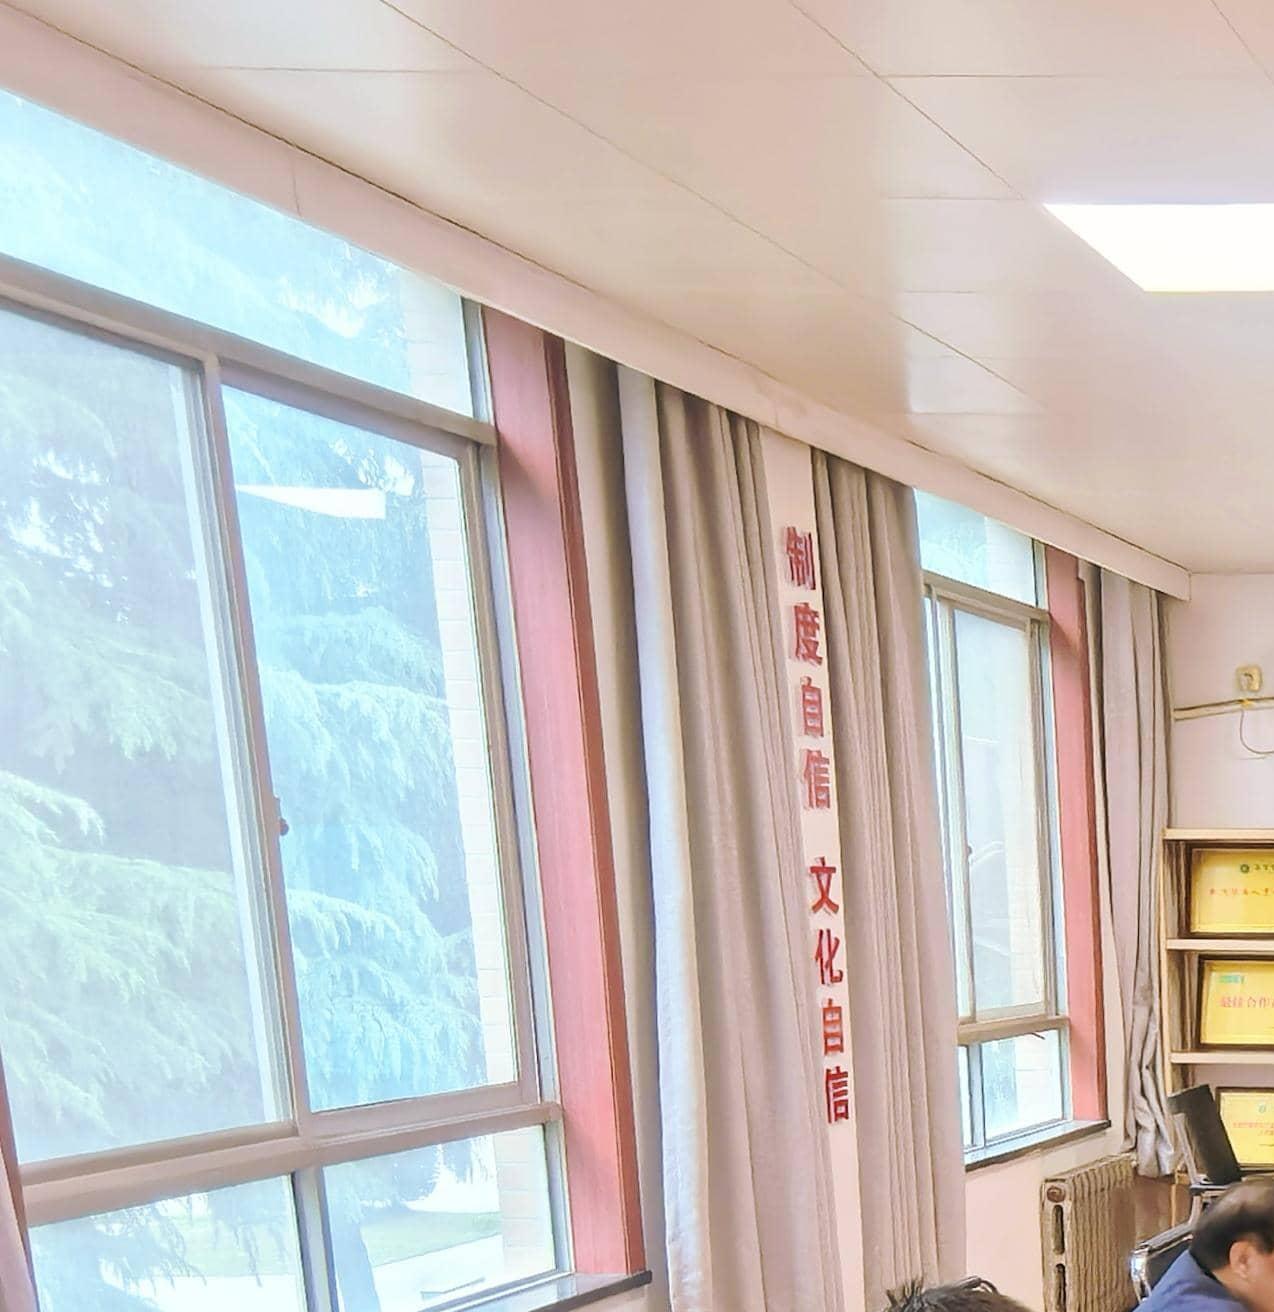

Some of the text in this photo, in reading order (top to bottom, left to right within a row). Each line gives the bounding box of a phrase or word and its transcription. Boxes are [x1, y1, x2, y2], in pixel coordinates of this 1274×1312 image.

[784, 526, 850, 1124] 制度自信 文化自信
